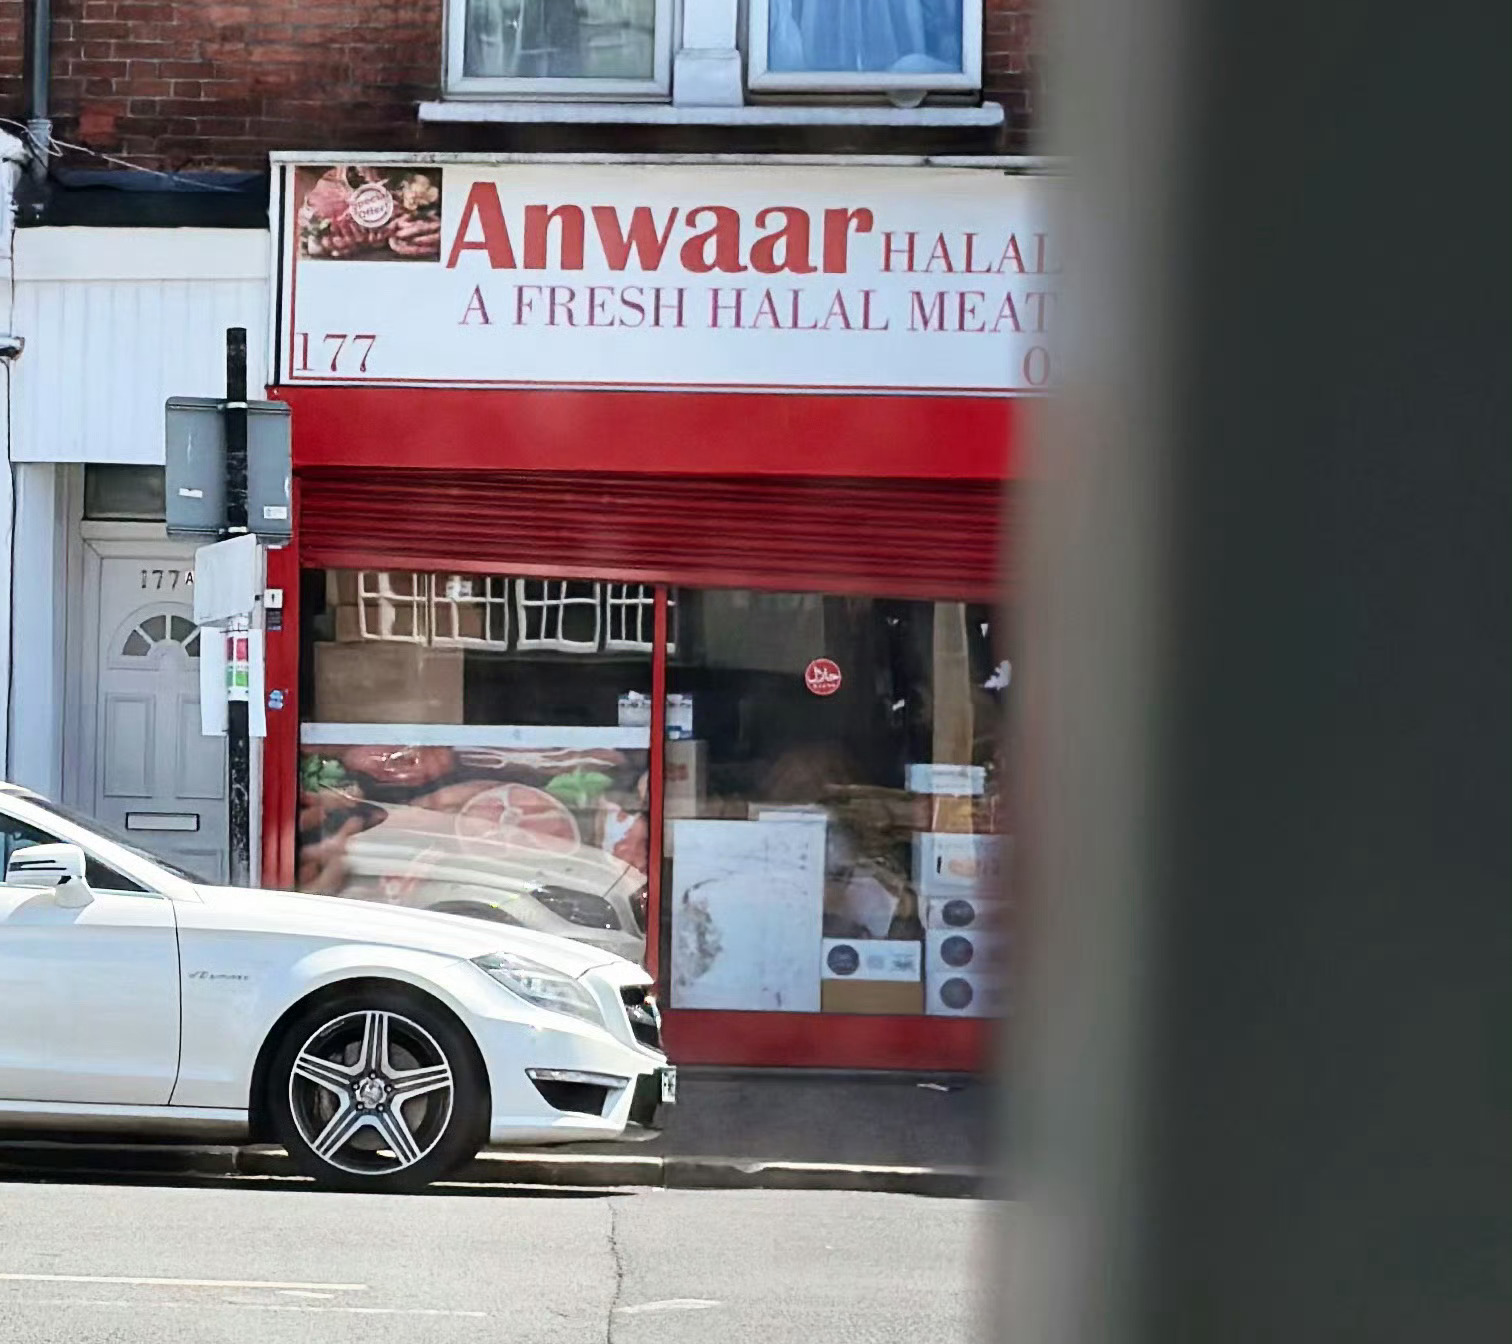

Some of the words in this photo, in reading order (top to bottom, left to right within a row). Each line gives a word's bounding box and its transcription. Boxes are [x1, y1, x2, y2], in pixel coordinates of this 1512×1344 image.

[446, 181, 874, 273] Anwaar
[880, 231, 1062, 274] HALAL
[458, 283, 493, 326] A
[513, 284, 689, 329] FRESH
[707, 287, 889, 331] HALAL
[295, 332, 378, 373] 177
